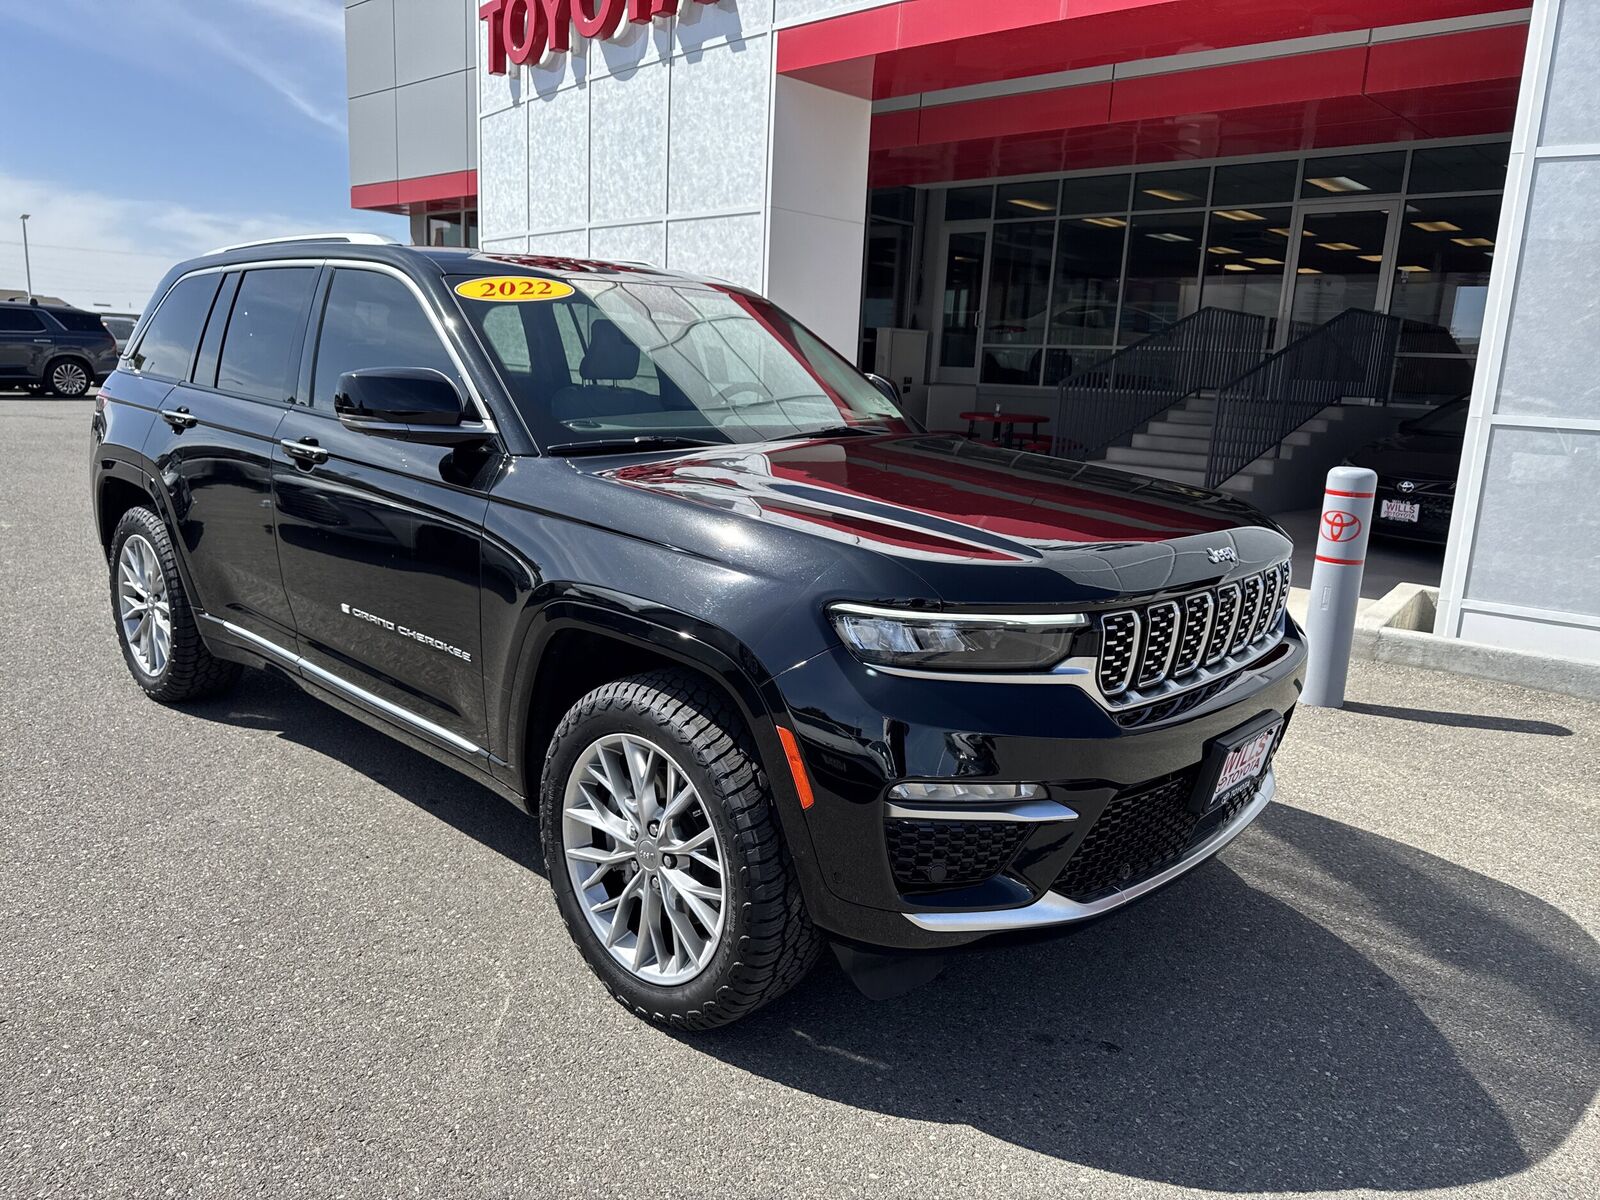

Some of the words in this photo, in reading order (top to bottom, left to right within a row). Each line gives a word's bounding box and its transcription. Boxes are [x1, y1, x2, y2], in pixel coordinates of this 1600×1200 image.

[479, 0, 721, 75] TOYO
[480, 281, 552, 297] 2022
[1386, 503, 1416, 514] WILLS
[1392, 511, 1416, 519] TOYOTA
[1206, 546, 1236, 563] Jeep
[352, 607, 395, 631] GRAND
[397, 625, 472, 662] CHEROKEE
[1223, 731, 1269, 777] WILLS
[1227, 758, 1260, 786] TOYOTA
